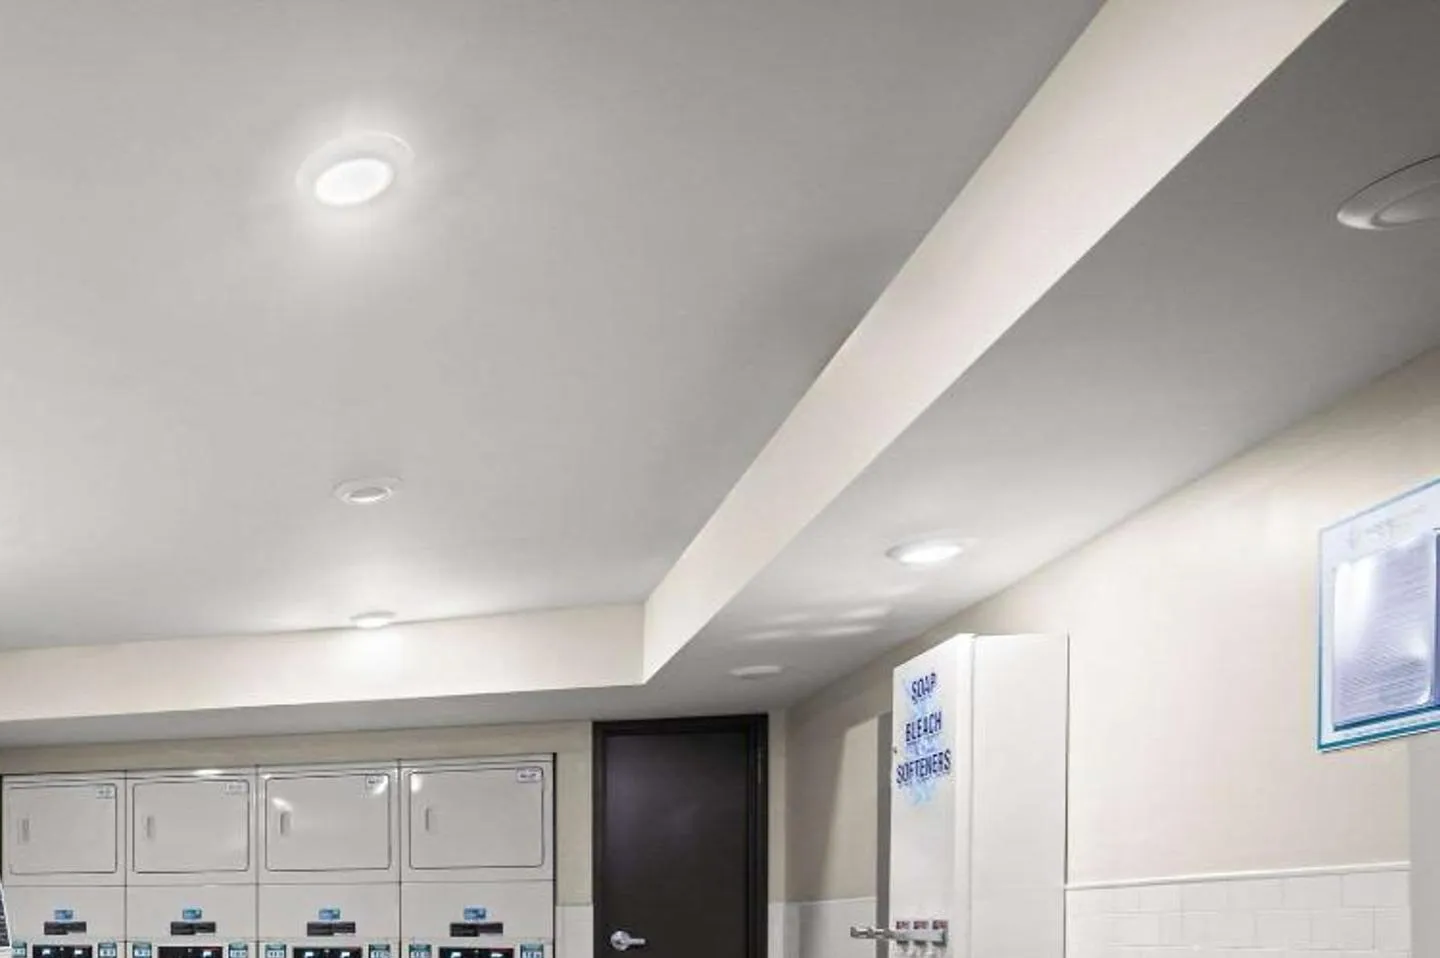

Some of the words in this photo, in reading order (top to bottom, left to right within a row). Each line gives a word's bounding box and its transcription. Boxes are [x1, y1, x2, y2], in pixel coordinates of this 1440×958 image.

[911, 672, 937, 704] SOAP
[905, 711, 942, 742] BLEACH
[896, 748, 952, 786] SOFTENERS
